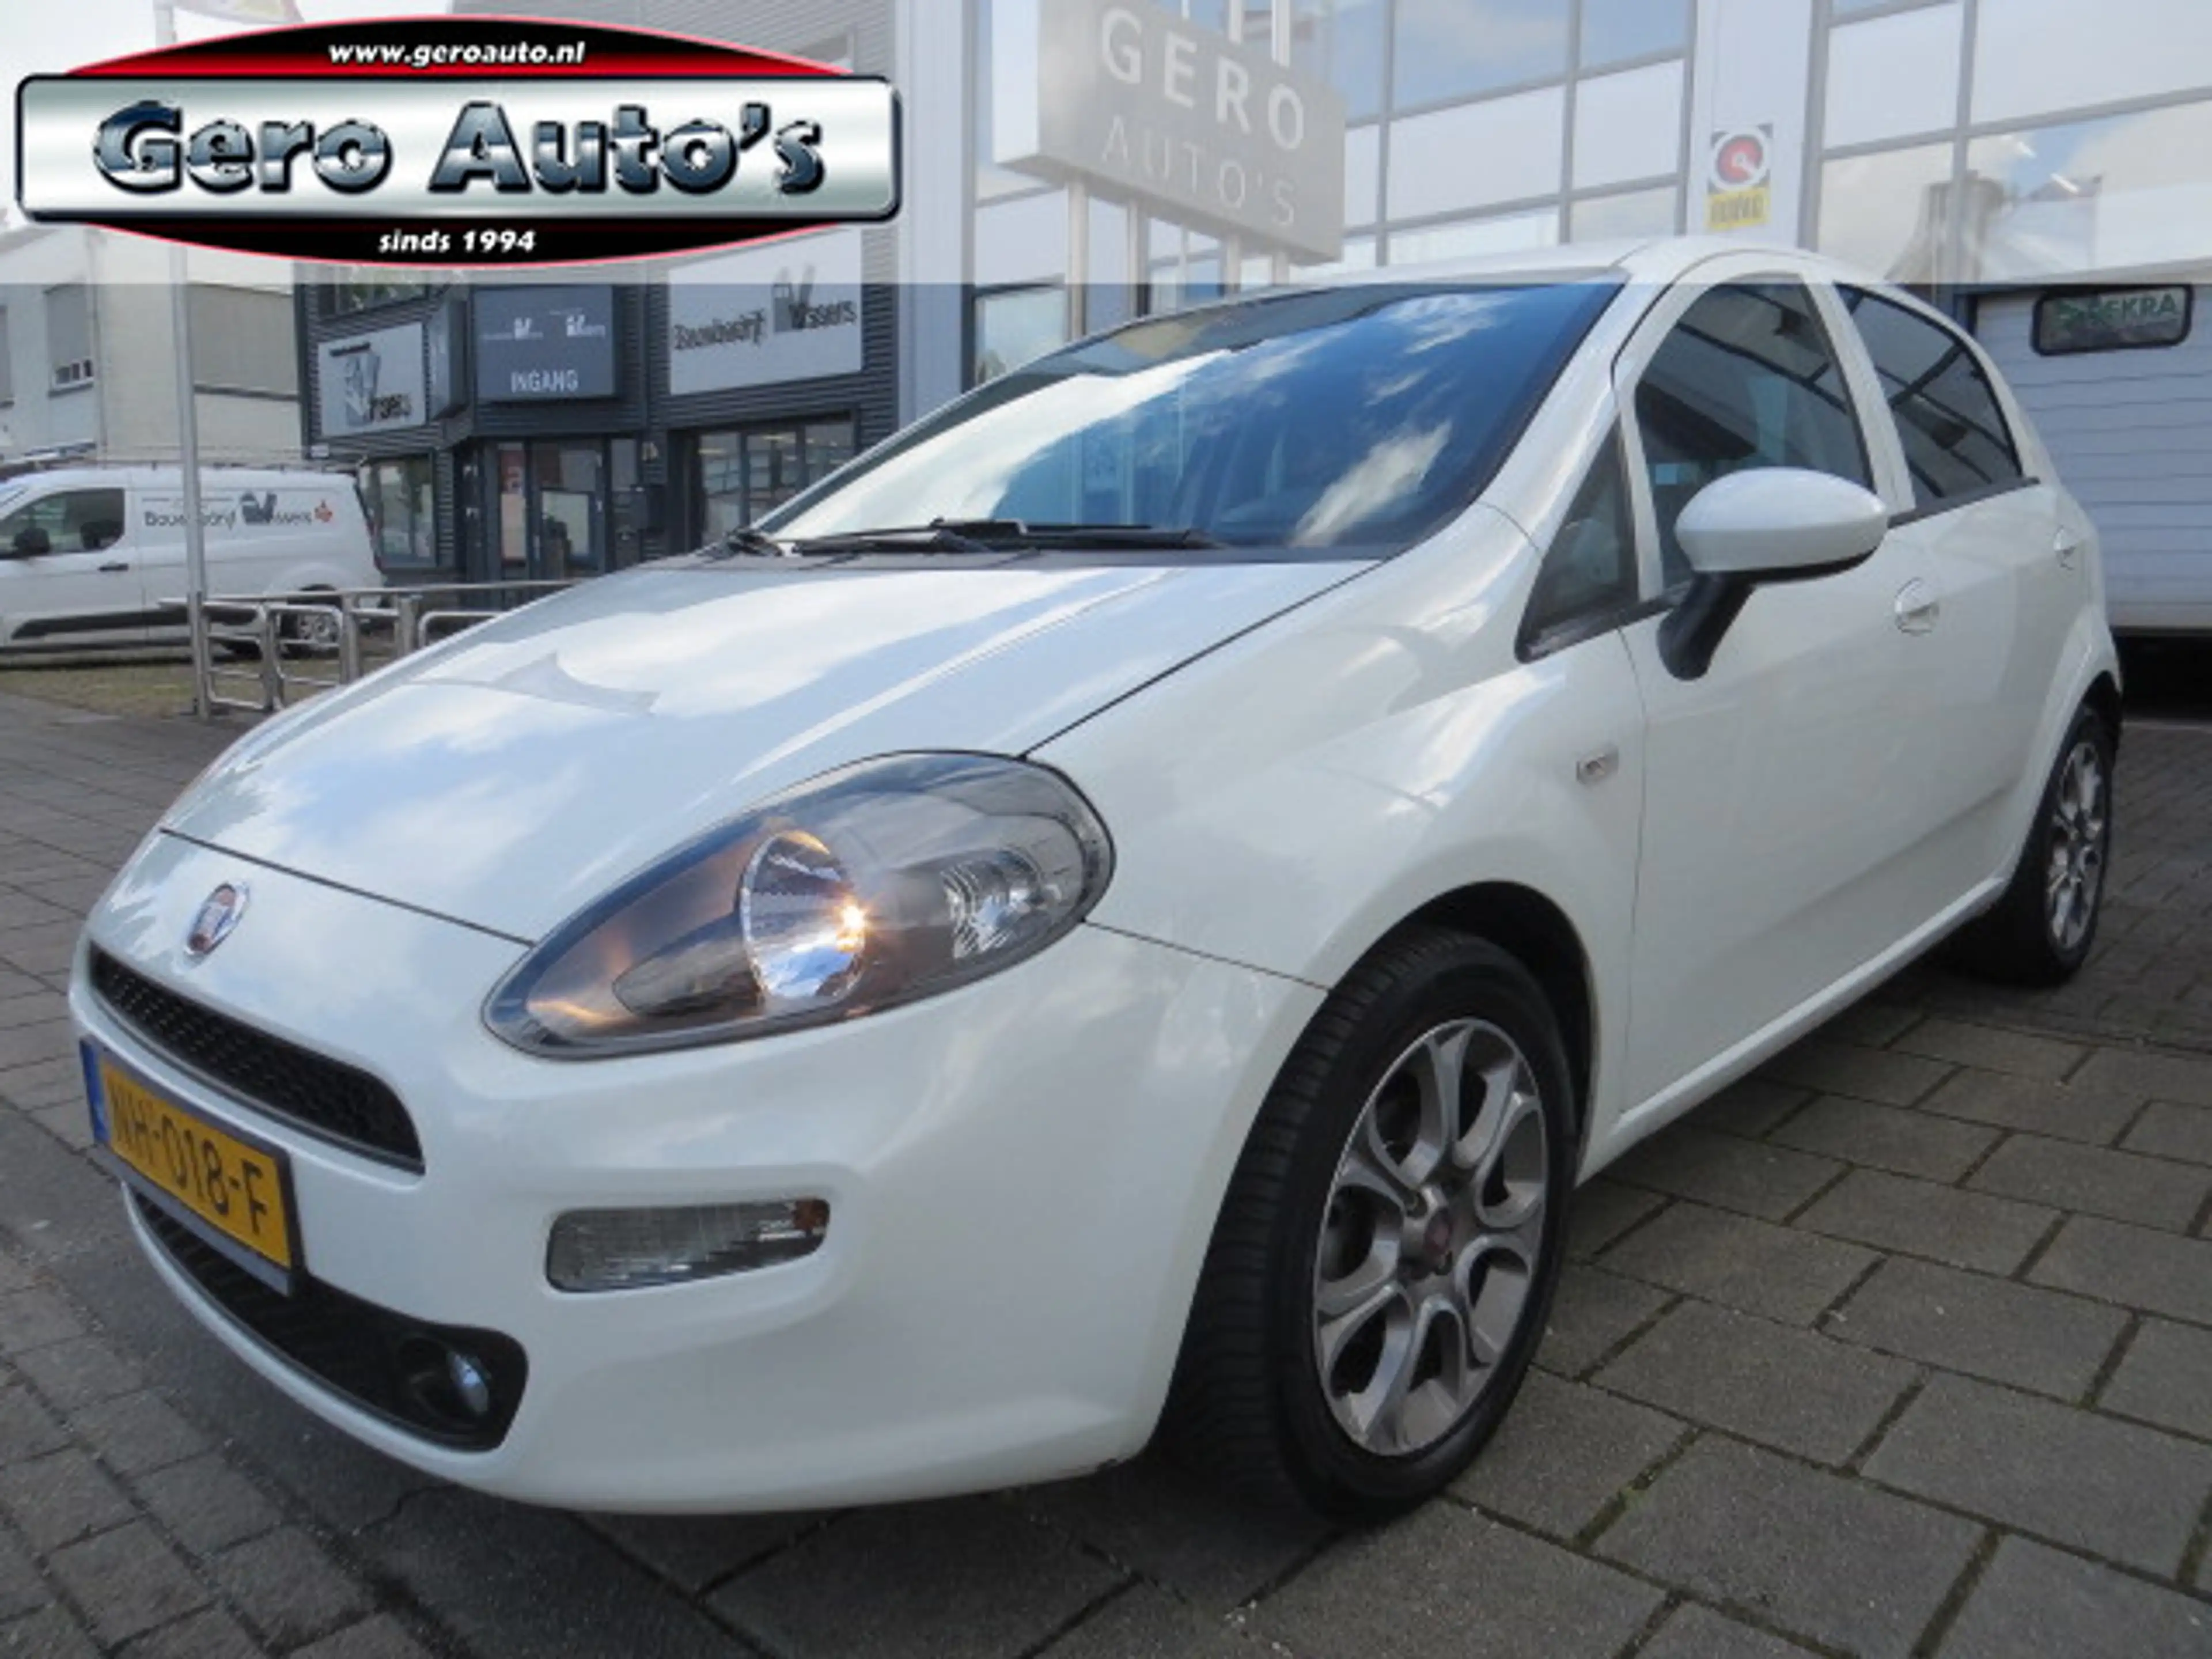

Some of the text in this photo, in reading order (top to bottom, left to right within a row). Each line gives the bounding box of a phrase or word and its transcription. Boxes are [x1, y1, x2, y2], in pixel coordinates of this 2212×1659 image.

[1100, 7, 1305, 150] GERO
[1100, 115, 1297, 228] AUTO'S
[510, 369, 579, 394] INGANG
